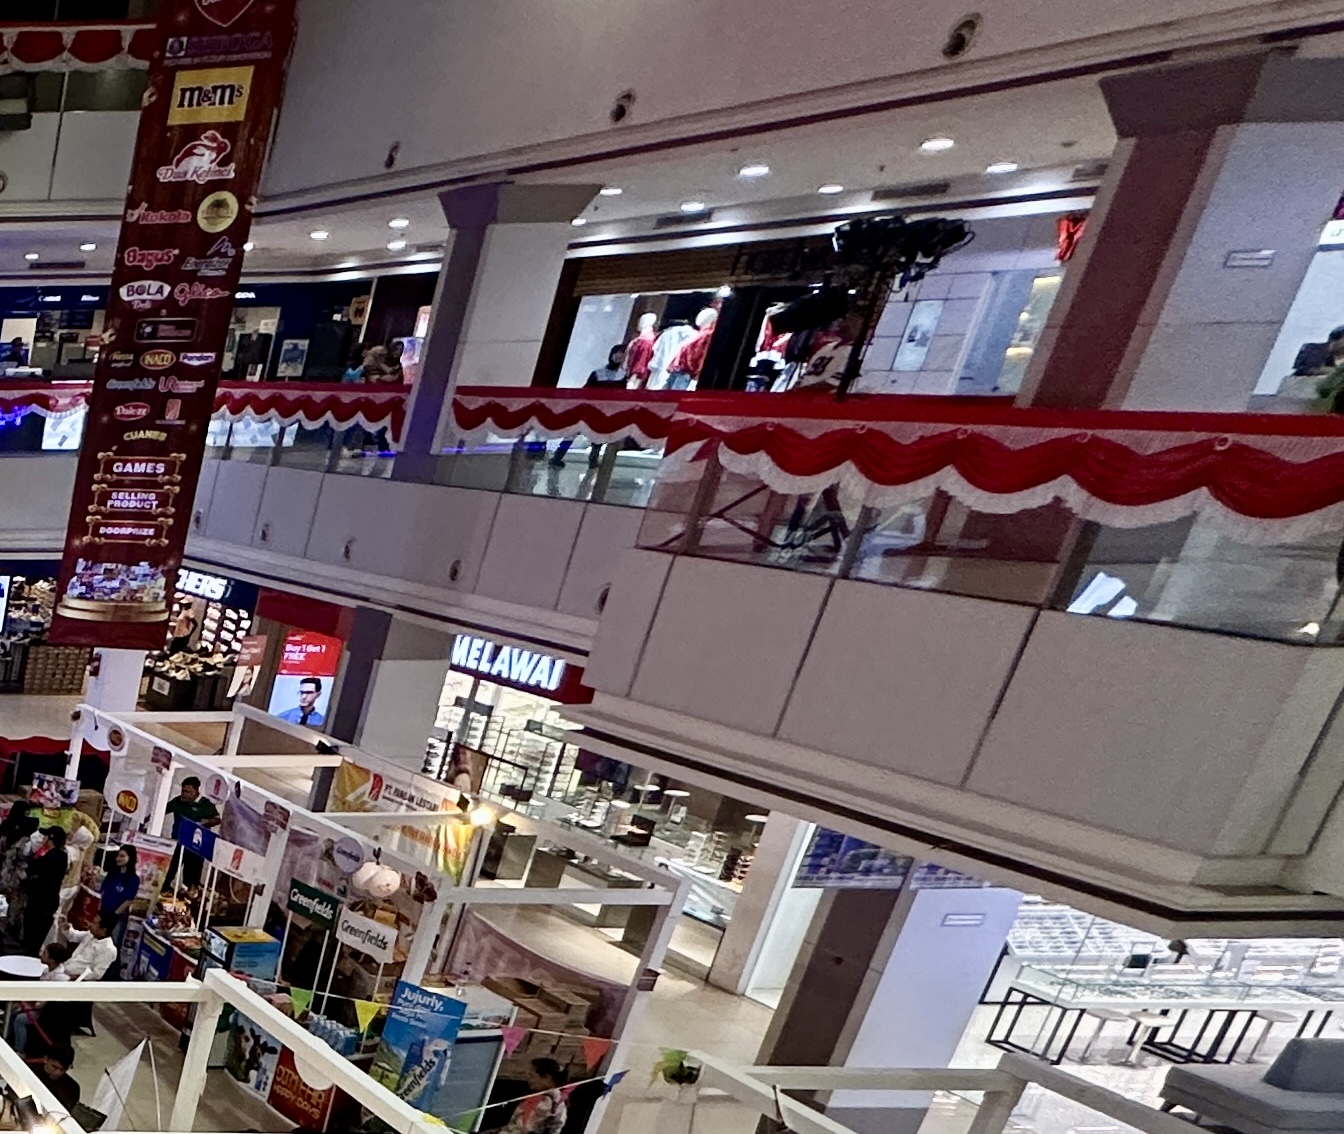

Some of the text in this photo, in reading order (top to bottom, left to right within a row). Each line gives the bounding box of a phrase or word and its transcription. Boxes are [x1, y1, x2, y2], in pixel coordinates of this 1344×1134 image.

[125, 247, 174, 270] Bagus
[126, 284, 164, 297] BOLA
[113, 462, 165, 474] GAMES
[108, 500, 159, 510] PRODUCT
[111, 492, 156, 500] SELLING
[451, 634, 566, 690] MELAWAI
[290, 887, 334, 921] Greenfields
[341, 919, 389, 951] Greenfields
[399, 1059, 437, 1101] reenfields
